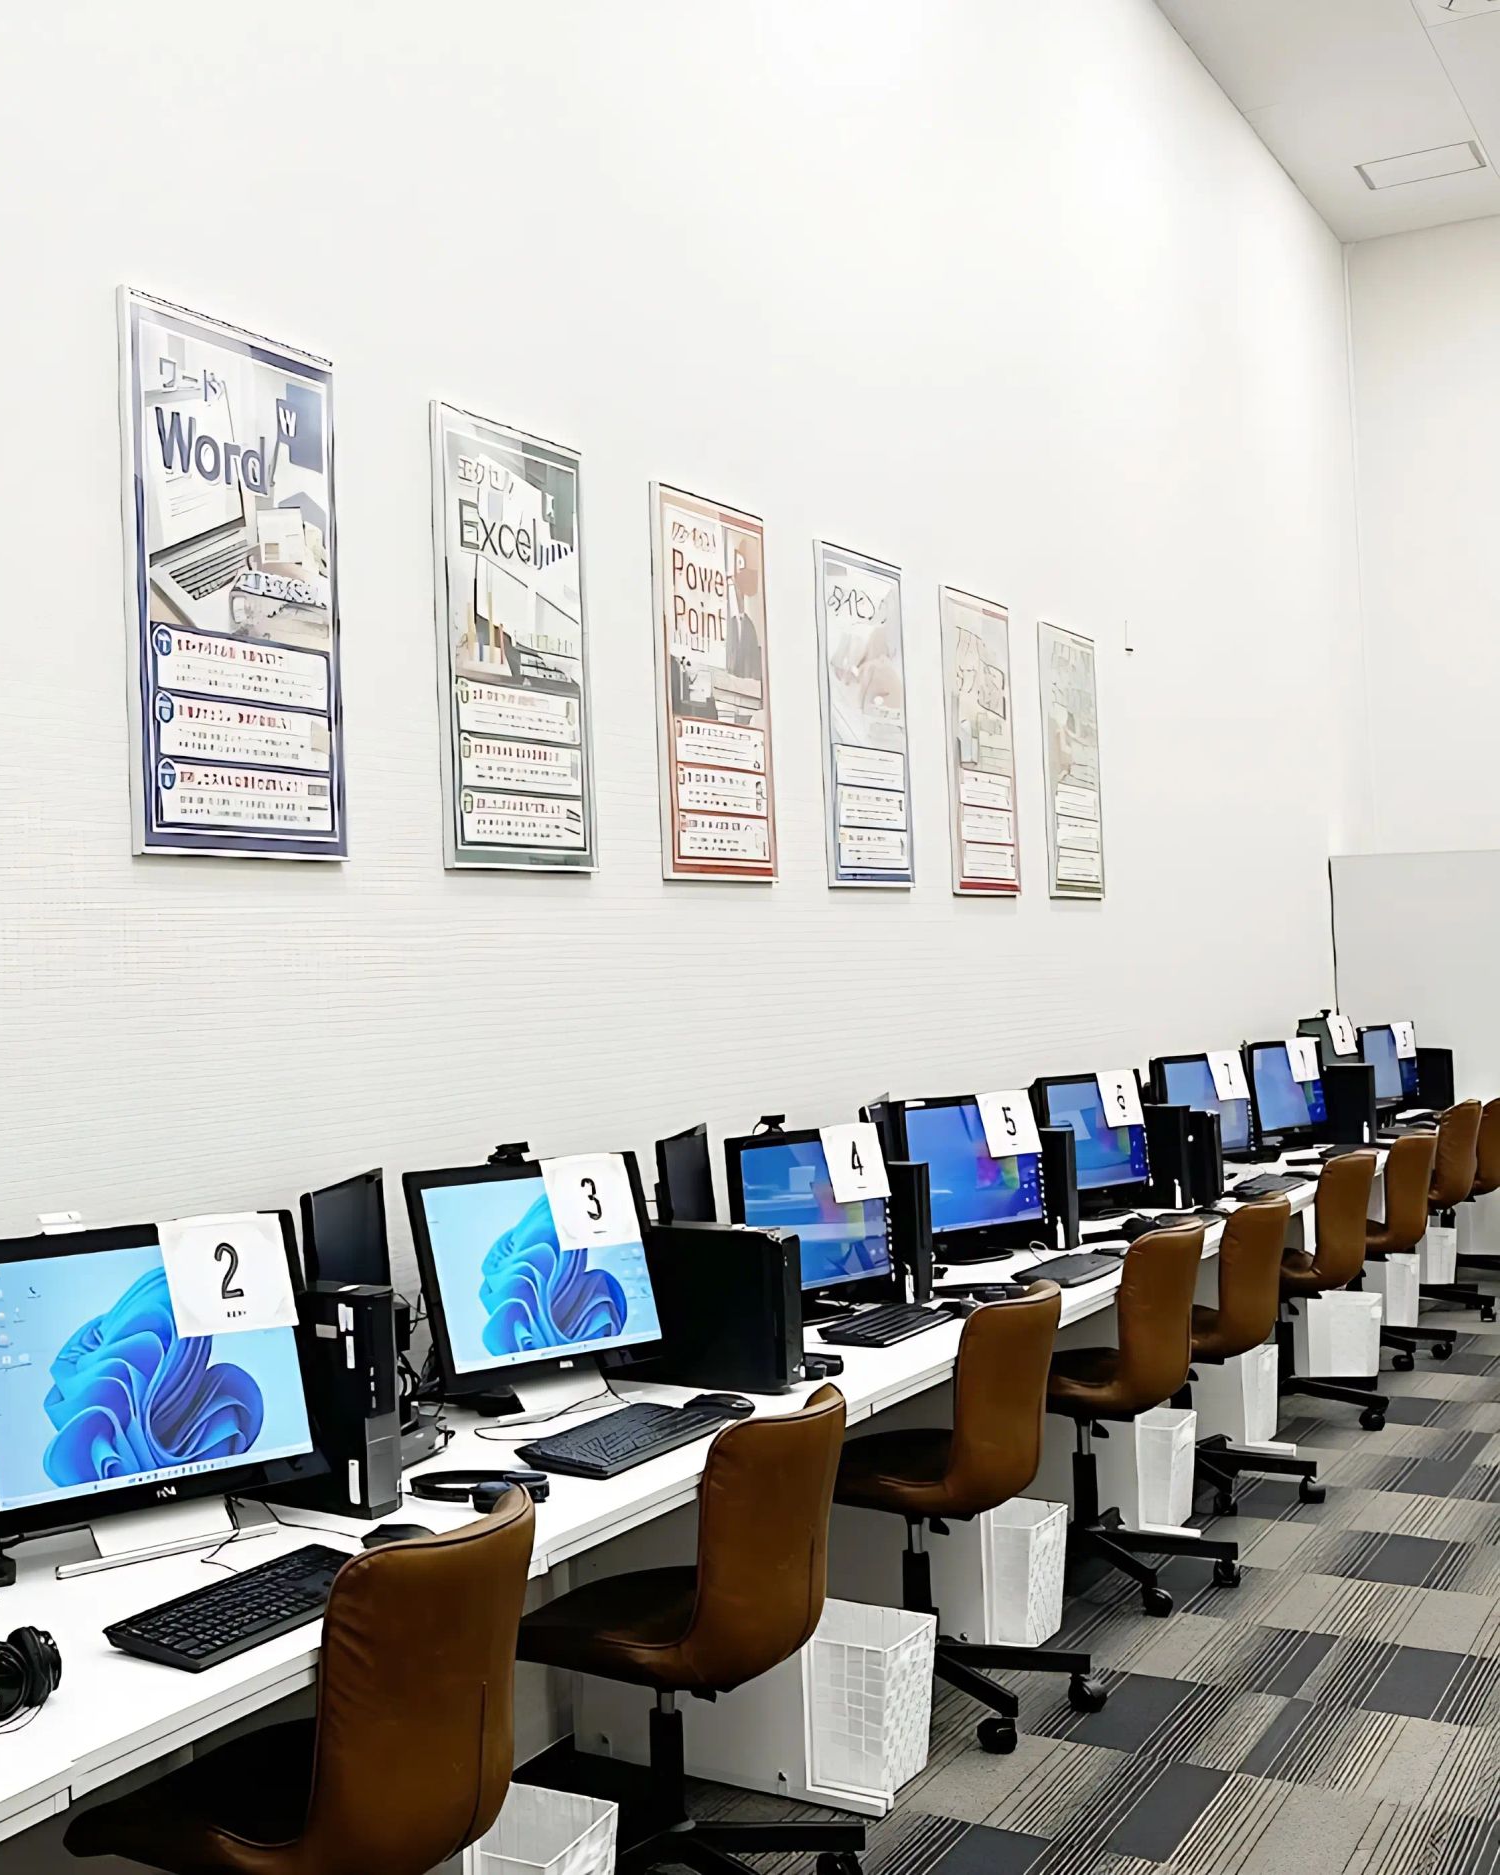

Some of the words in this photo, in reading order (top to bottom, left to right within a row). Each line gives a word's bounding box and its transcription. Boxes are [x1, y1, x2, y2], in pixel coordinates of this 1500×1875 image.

[155, 406, 268, 496] Word
[458, 498, 538, 566] Excel
[674, 595, 726, 641] Point
[1001, 1106, 1018, 1136] 5
[851, 1140, 864, 1176] 4
[580, 1177, 603, 1221] 3
[214, 1242, 245, 1299] 2
